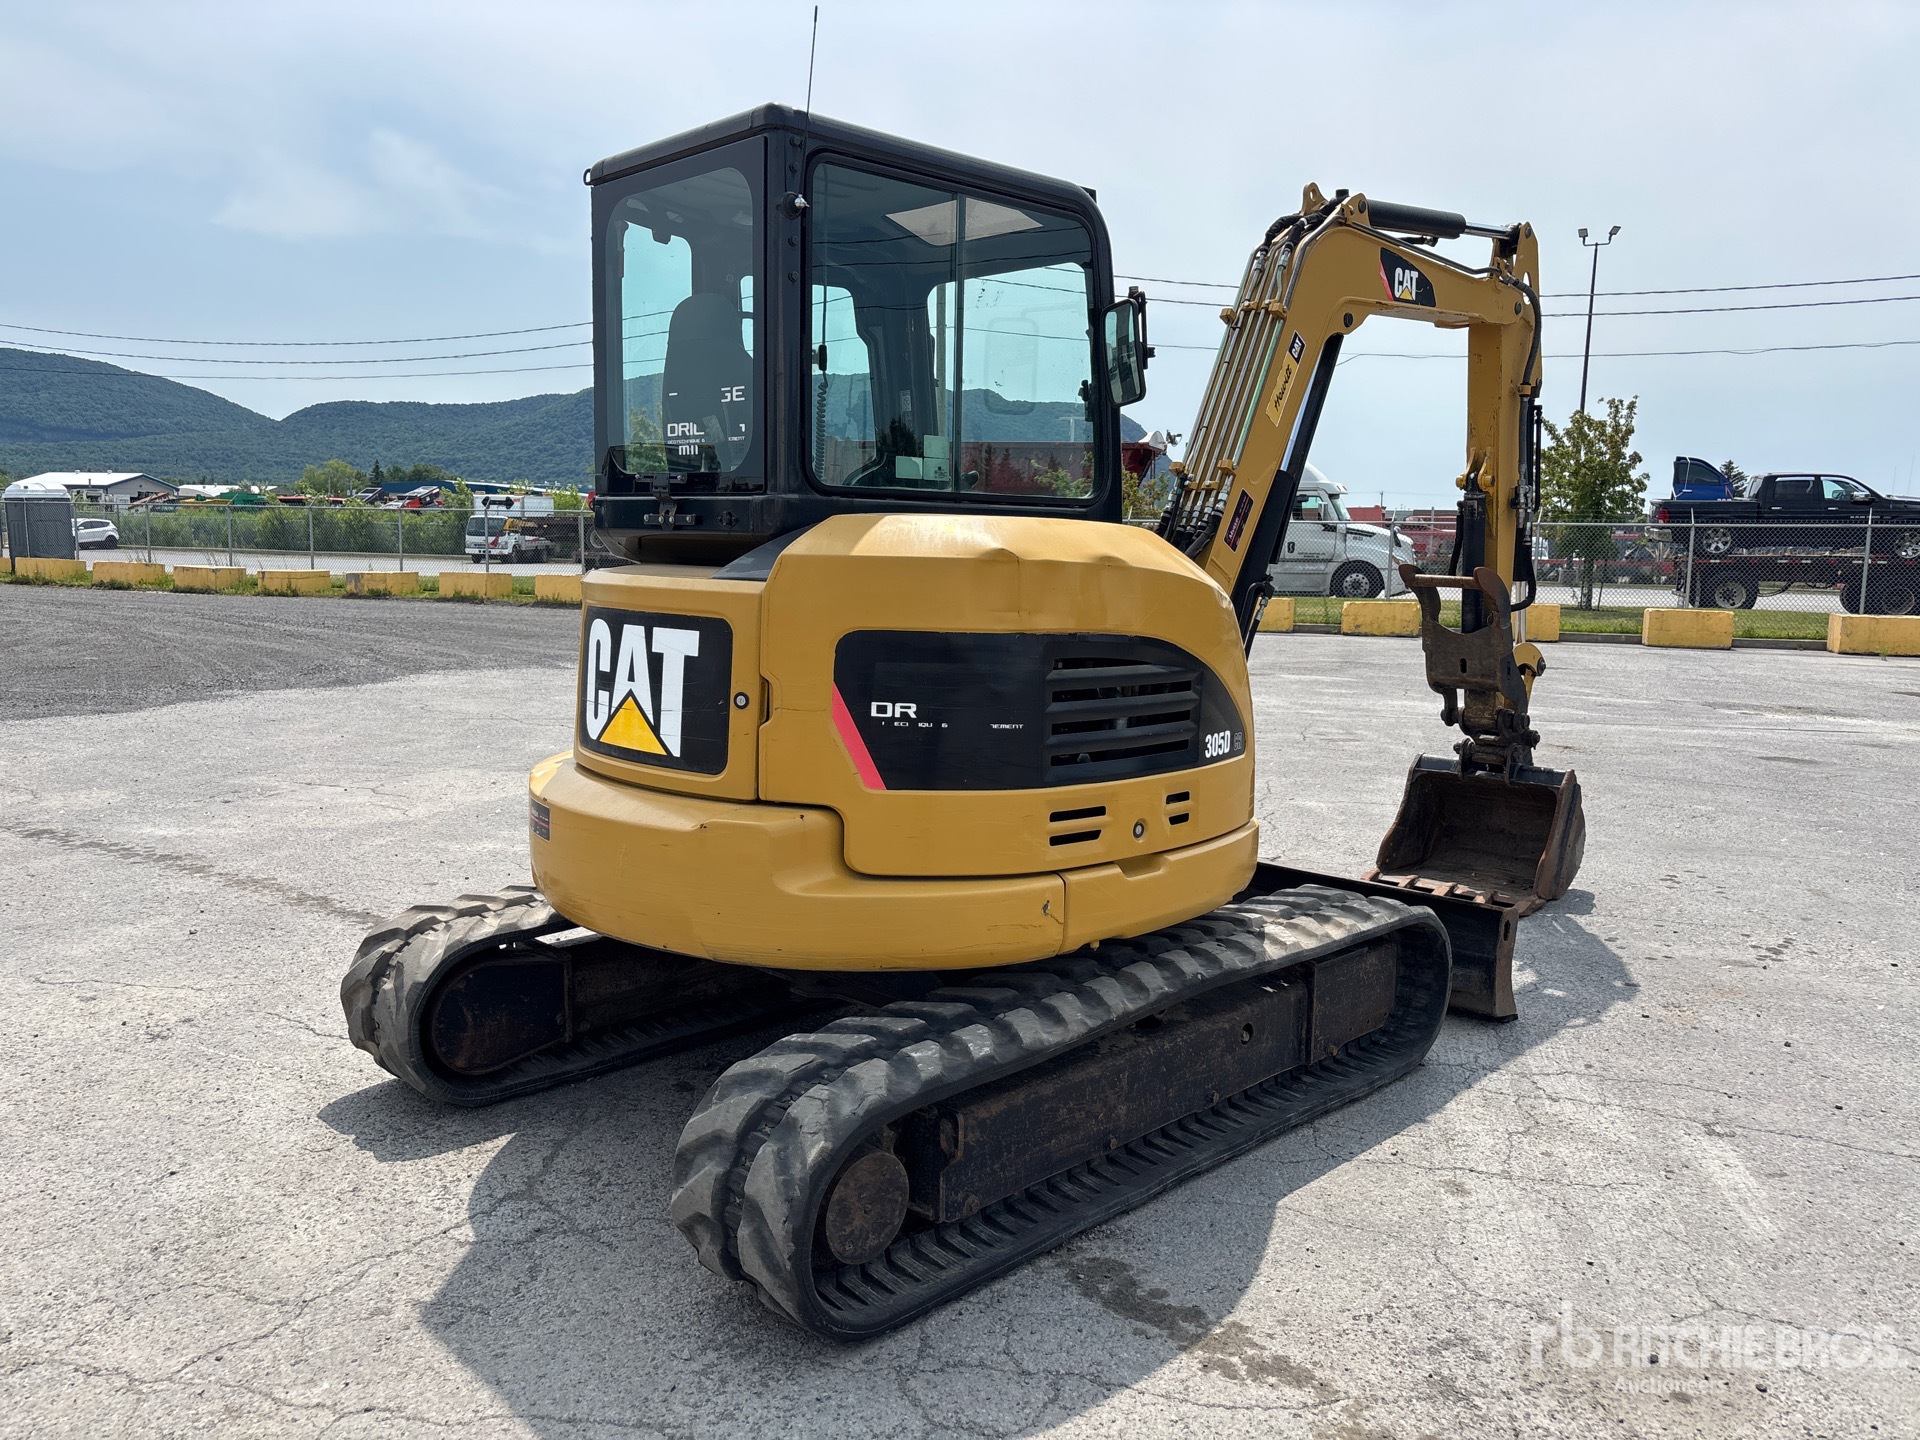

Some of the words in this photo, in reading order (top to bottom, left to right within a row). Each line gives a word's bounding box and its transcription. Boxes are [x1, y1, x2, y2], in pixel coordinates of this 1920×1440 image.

[1394, 267, 1419, 301] CAT
[1291, 337, 1302, 359] CAT
[585, 618, 700, 758] CAT
[1204, 730, 1231, 759] 305D
